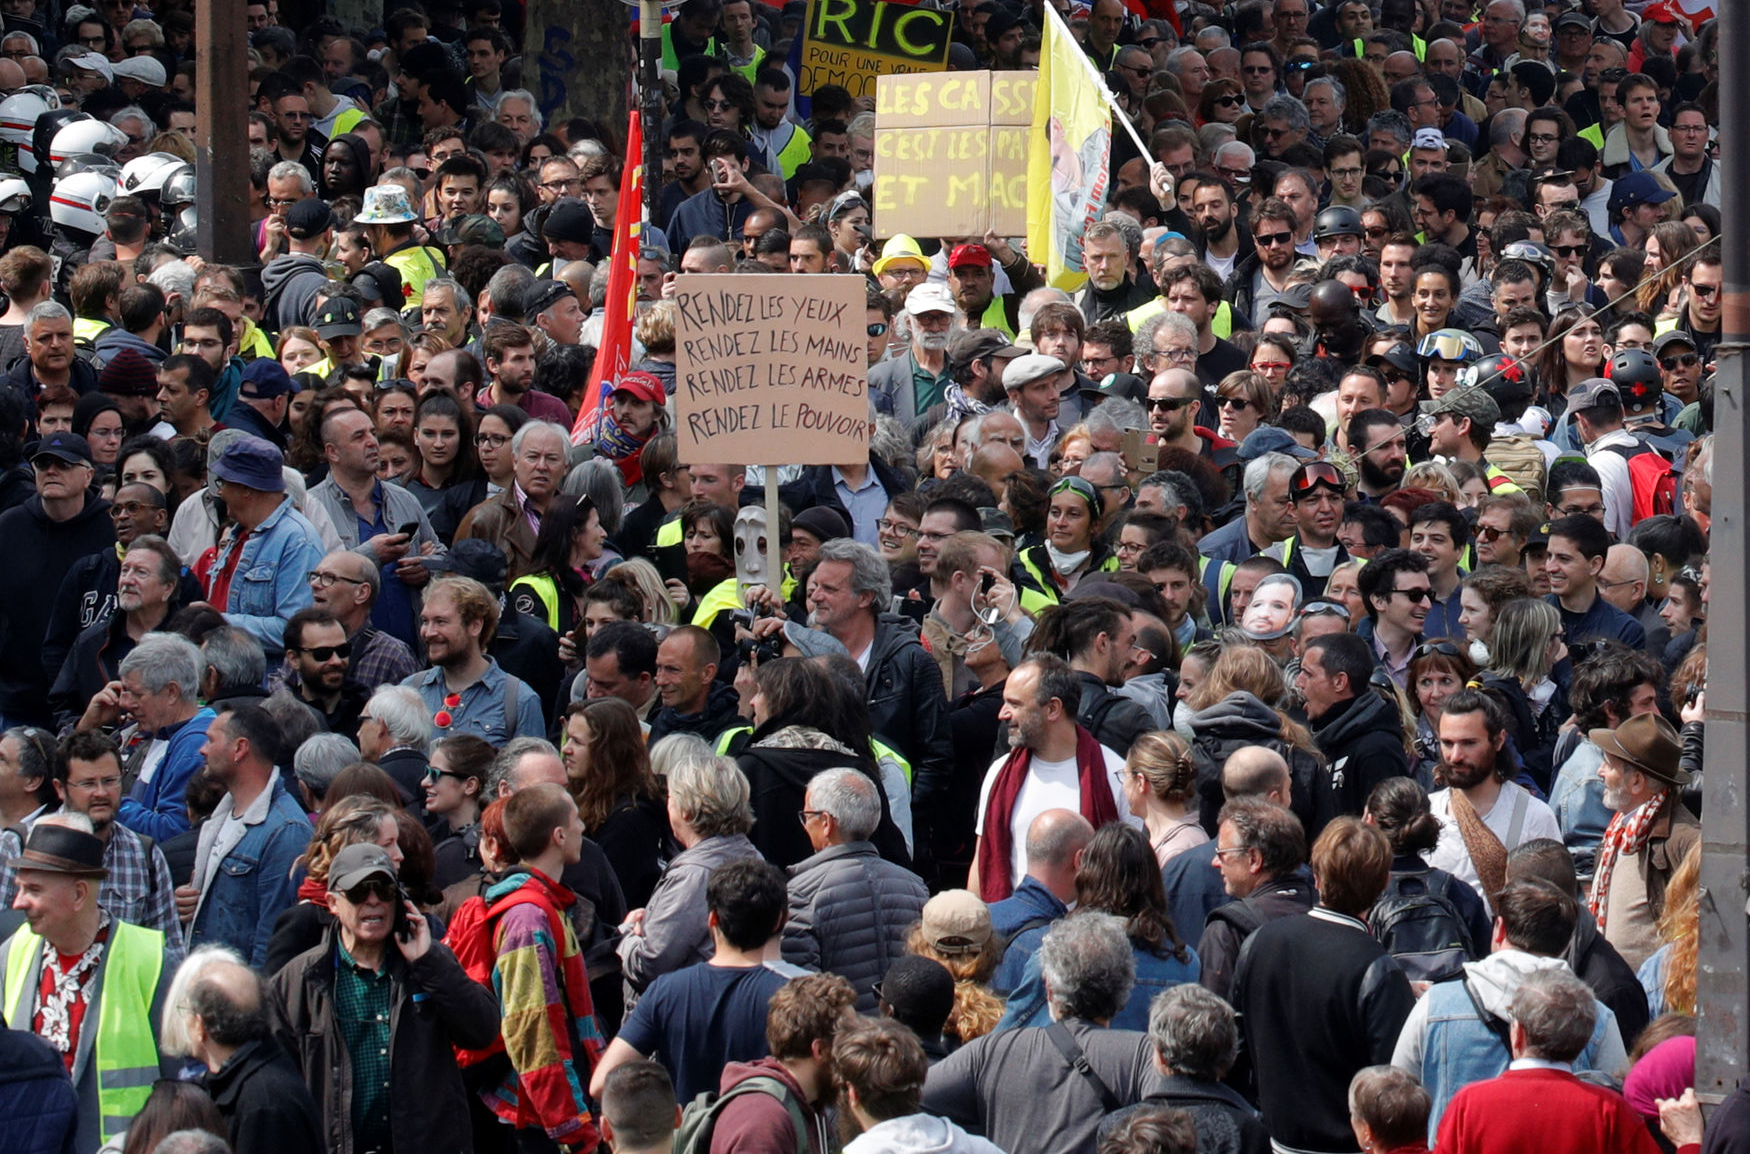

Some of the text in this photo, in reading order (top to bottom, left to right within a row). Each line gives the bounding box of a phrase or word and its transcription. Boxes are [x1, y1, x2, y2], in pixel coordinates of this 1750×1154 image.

[809, 46, 850, 67] POUR
[856, 56, 882, 74] UNE
[878, 81, 934, 116] LES
[875, 170, 1029, 210] ET MAC
[676, 287, 848, 333] RENDEZ LES YEUX
[683, 329, 862, 368] RENDEZ LES MAINS
[686, 364, 759, 402] RENDEZ
[768, 364, 797, 387] LES
[801, 366, 865, 398] ARMES
[687, 402, 866, 446] RENDEZ LE POUVOIR
[80, 590, 120, 629] GA
